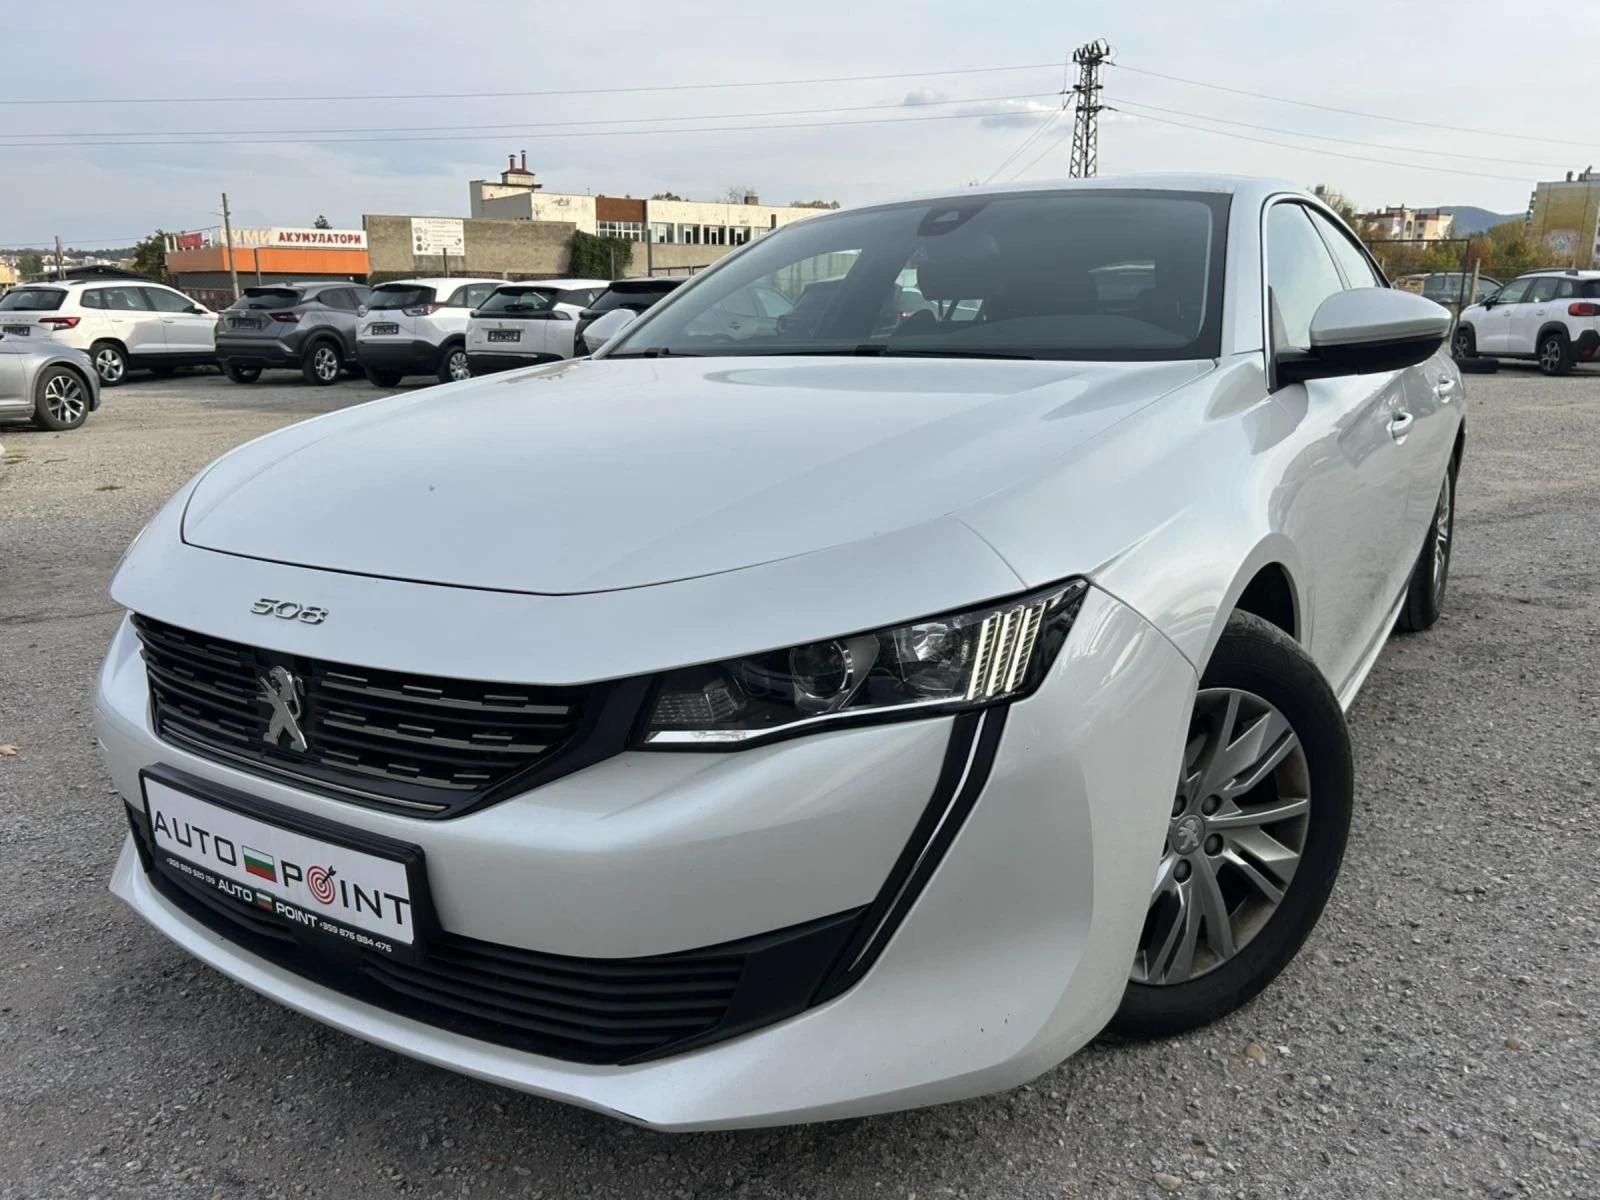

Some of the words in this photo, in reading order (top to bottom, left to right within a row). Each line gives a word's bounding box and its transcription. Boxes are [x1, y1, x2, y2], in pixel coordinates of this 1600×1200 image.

[278, 231, 362, 245] АКУМУЛАТОРИ
[250, 597, 329, 625] 508
[153, 810, 237, 866] AUTO
[218, 879, 253, 902] AUTO
[276, 901, 318, 928] POINT
[319, 921, 338, 934] +359
[375, 941, 393, 953] 476
